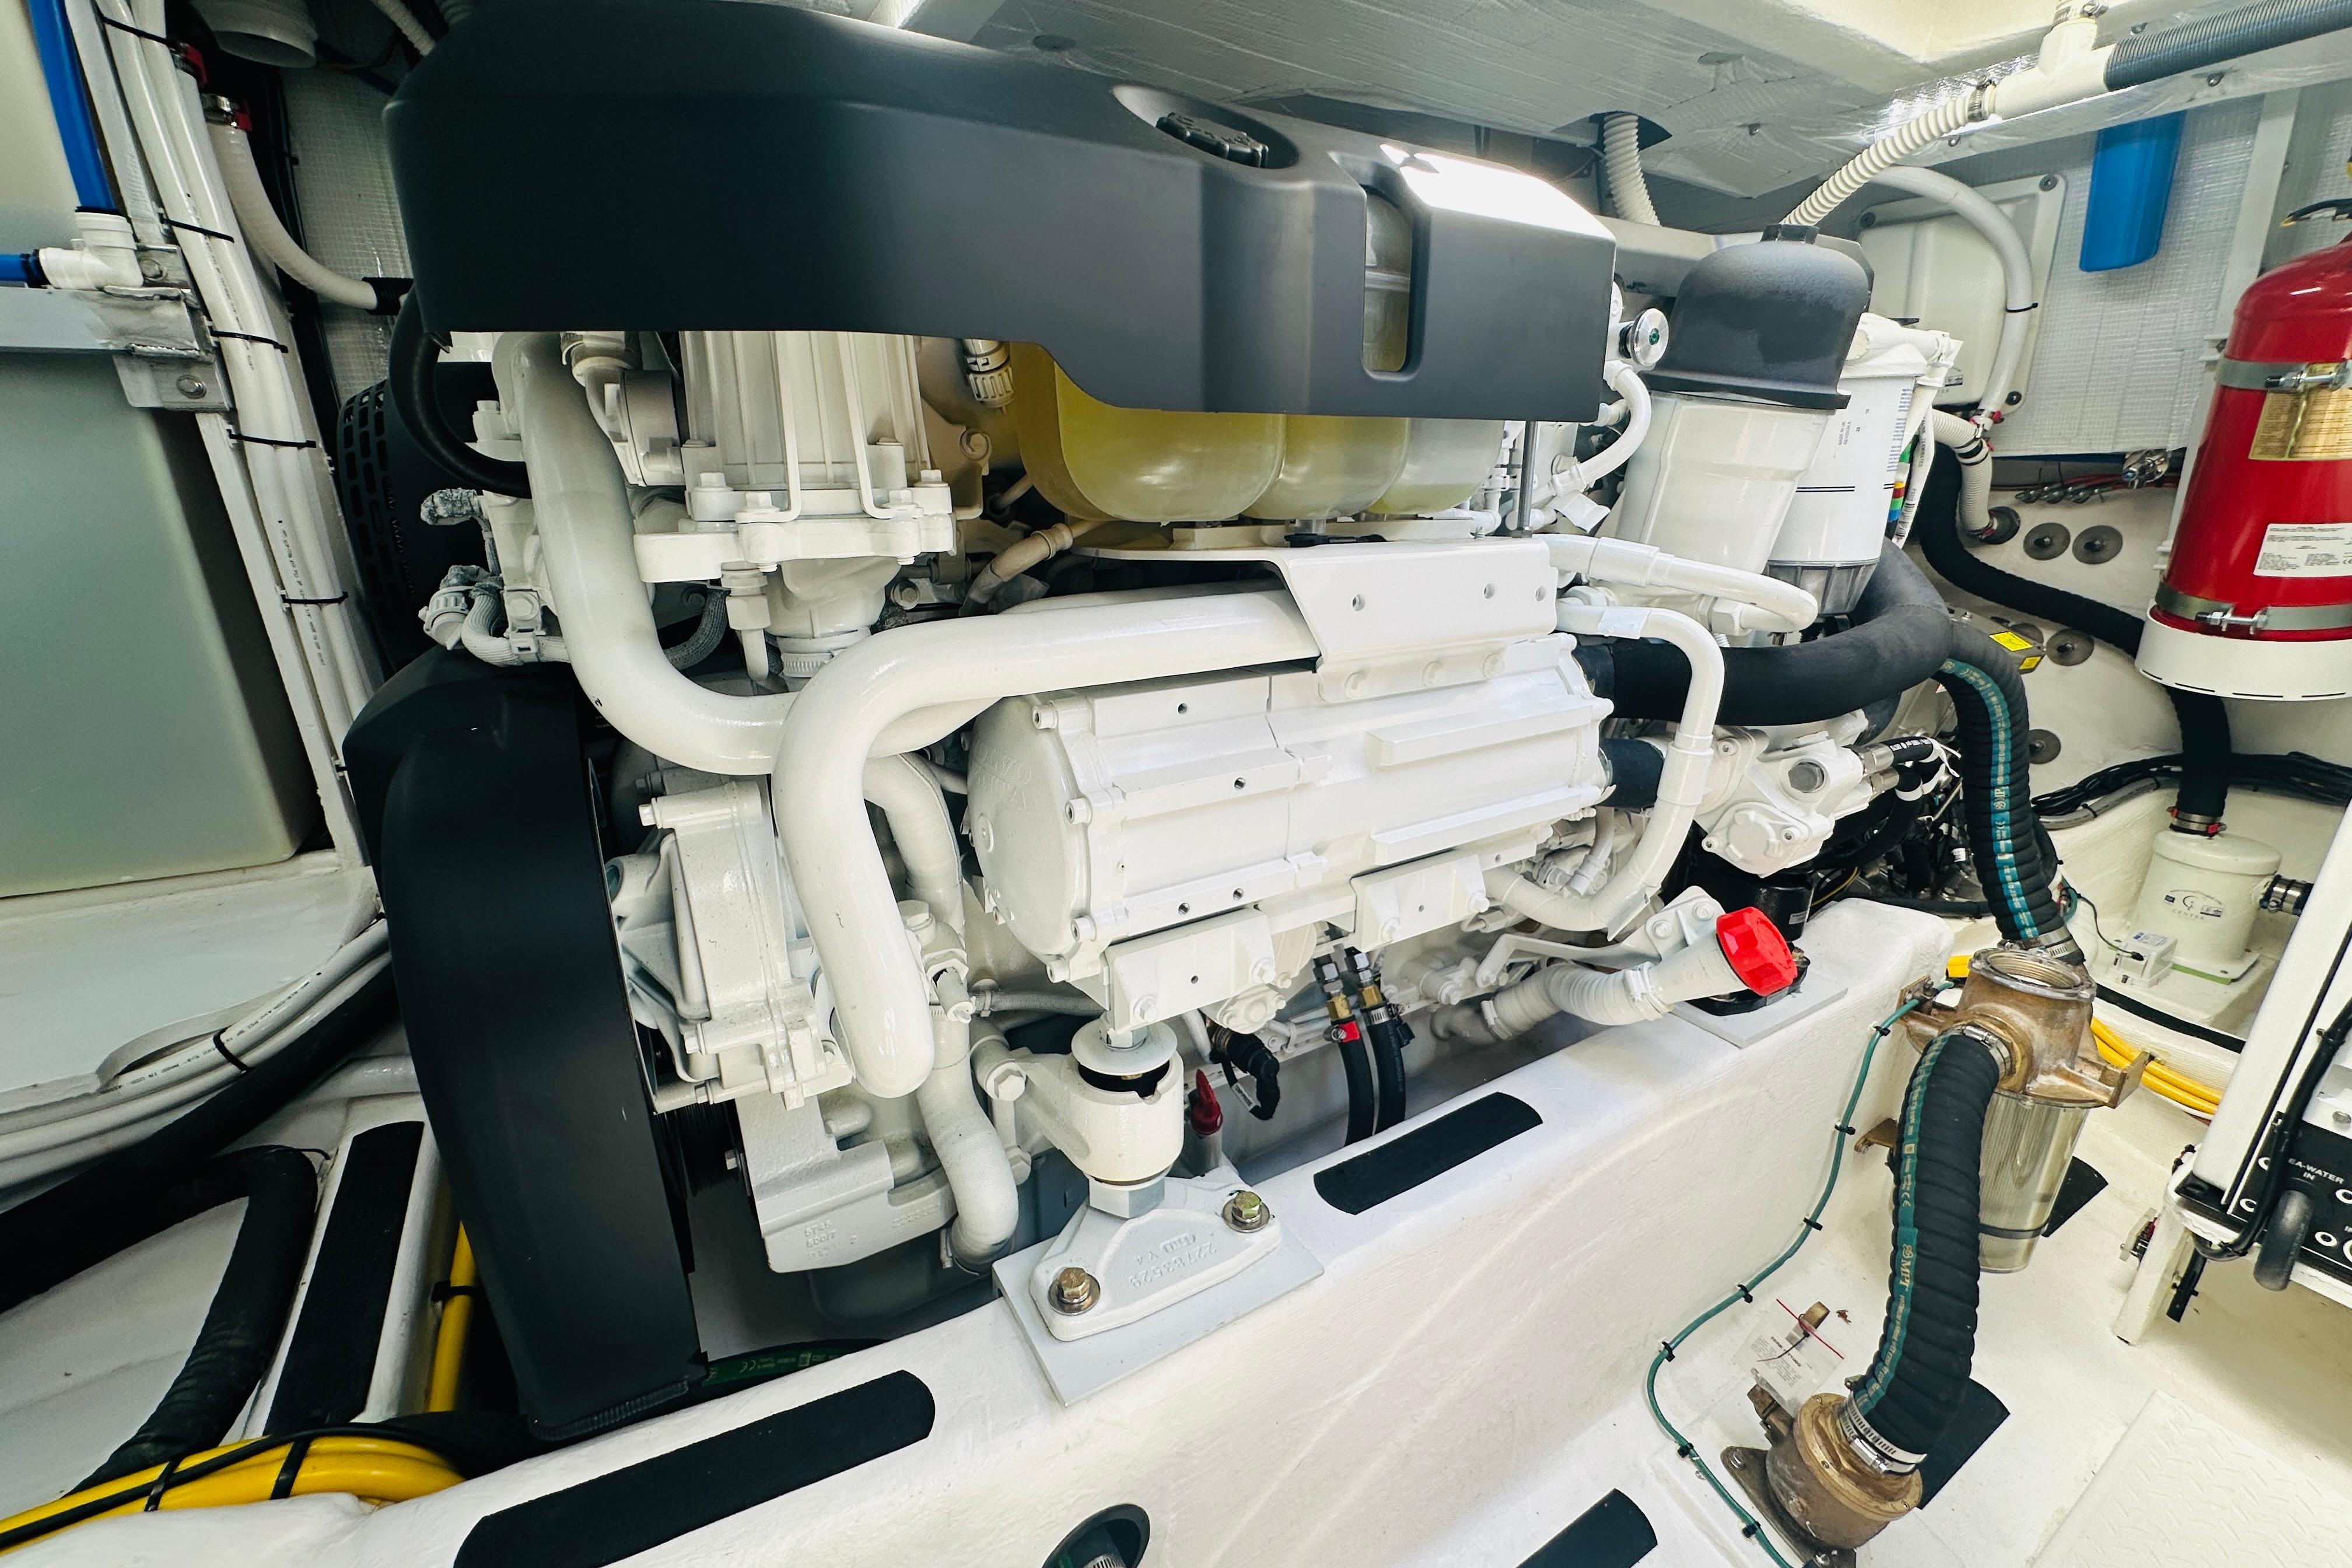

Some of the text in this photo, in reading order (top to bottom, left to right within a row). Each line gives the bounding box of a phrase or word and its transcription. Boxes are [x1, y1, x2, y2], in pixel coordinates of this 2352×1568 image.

[2288, 1157, 2344, 1184] EA-WATER
[2303, 1171, 2315, 1180] IN
[1770, 1335, 1783, 1349] ZERK
